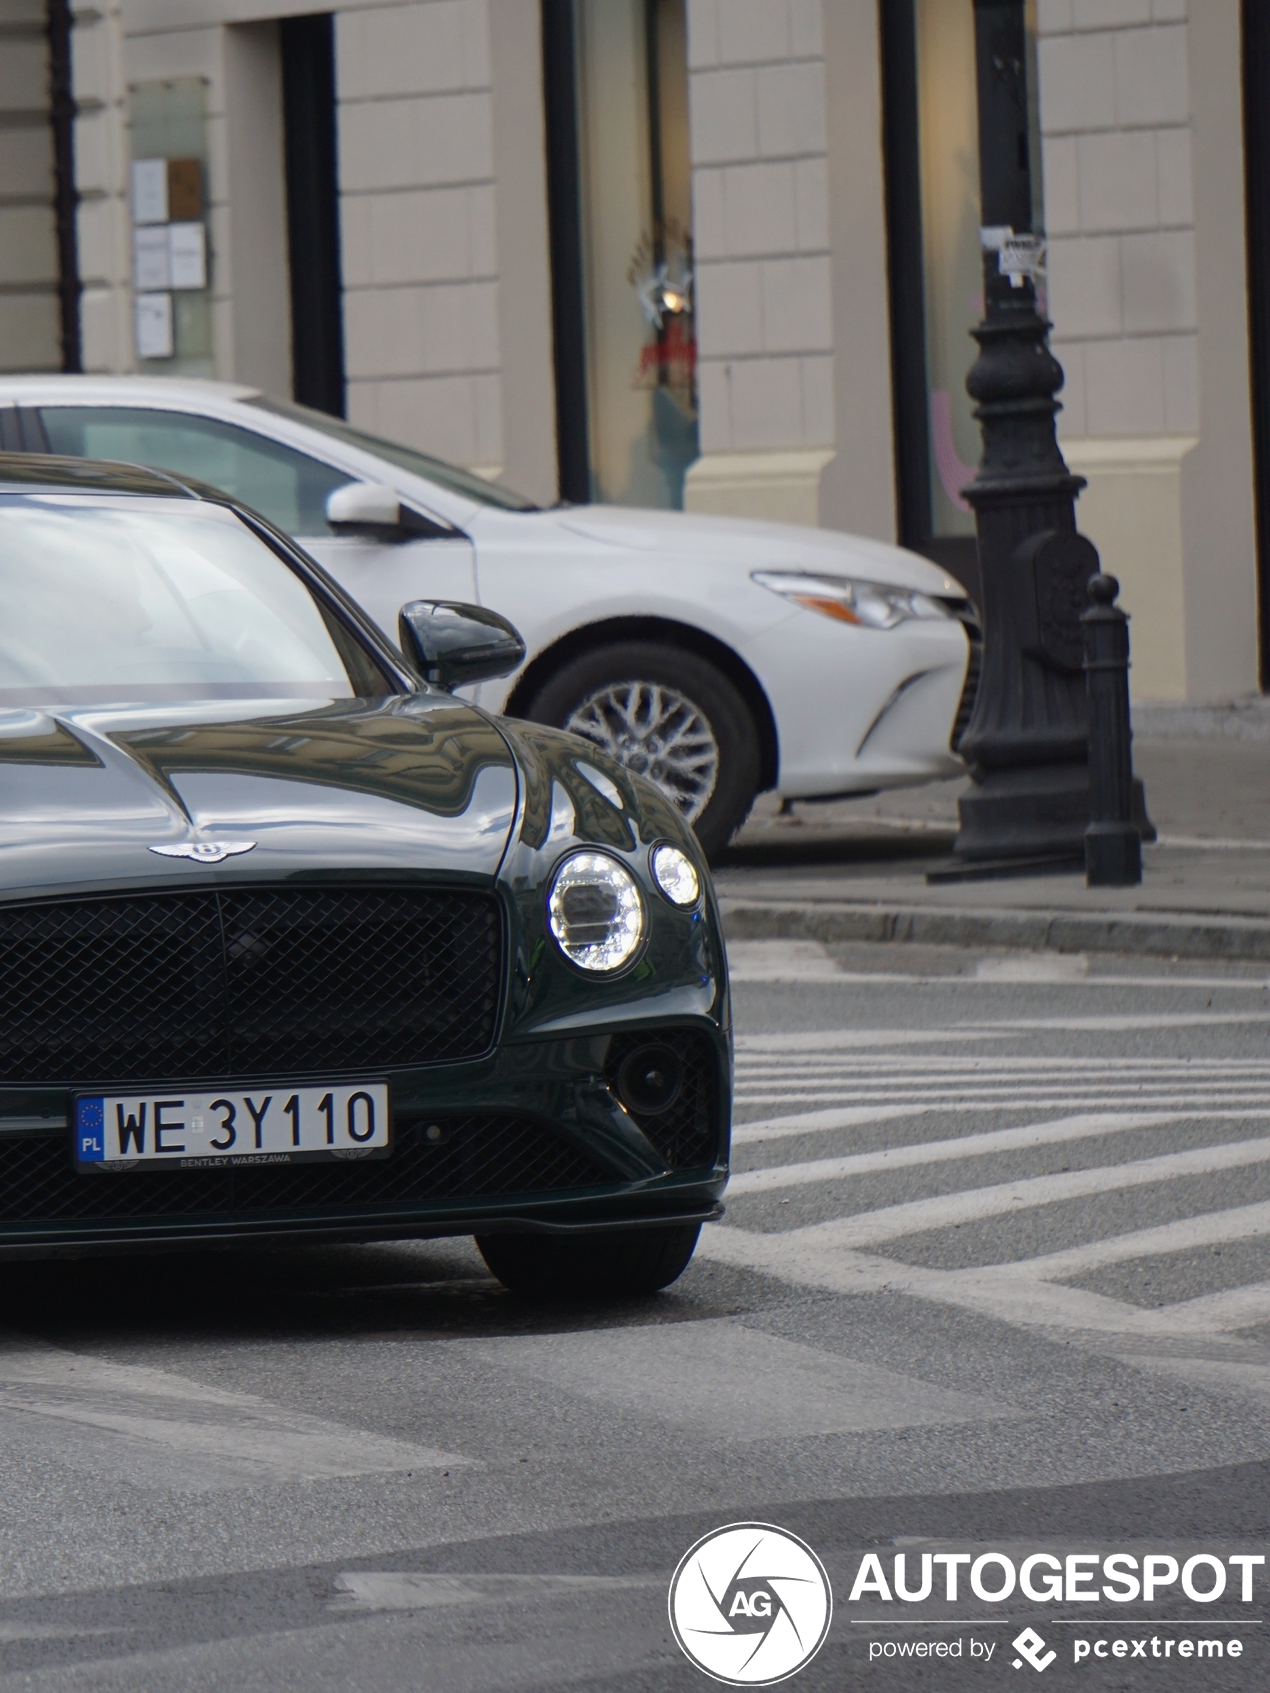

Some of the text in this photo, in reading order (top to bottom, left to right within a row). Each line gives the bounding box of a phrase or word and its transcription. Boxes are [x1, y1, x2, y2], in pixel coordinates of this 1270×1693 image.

[116, 1091, 376, 1154] WE 3Y110
[82, 1137, 101, 1152] PL
[180, 1153, 291, 1168] BENTLEY WARSZAWA
